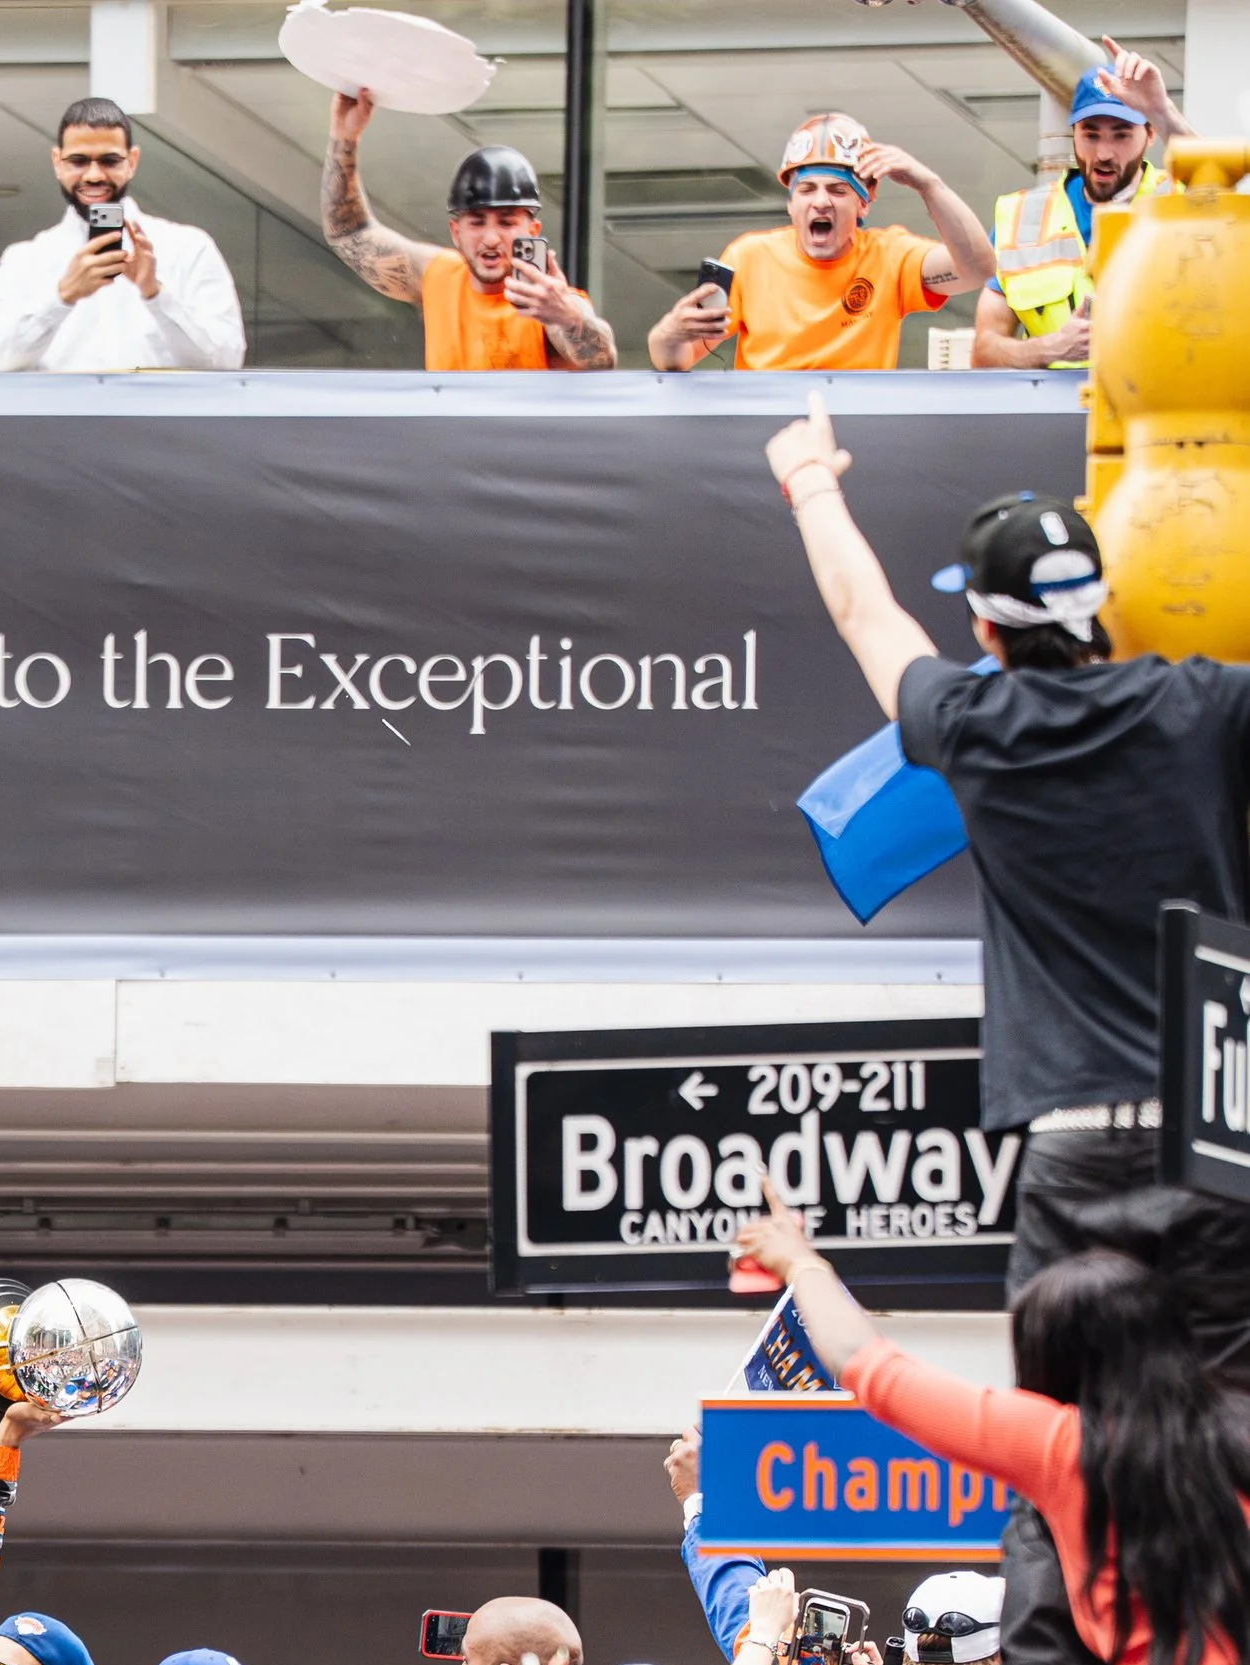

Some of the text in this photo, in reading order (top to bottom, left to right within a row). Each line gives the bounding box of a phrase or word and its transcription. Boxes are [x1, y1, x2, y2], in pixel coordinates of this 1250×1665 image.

[103, 630, 234, 710] the
[266, 630, 758, 735] Exceptional
[747, 1060, 927, 1116] 209-211
[1202, 999, 1250, 1136] Fu
[560, 1109, 1023, 1226] Broadway
[847, 1202, 978, 1239] HEROES
